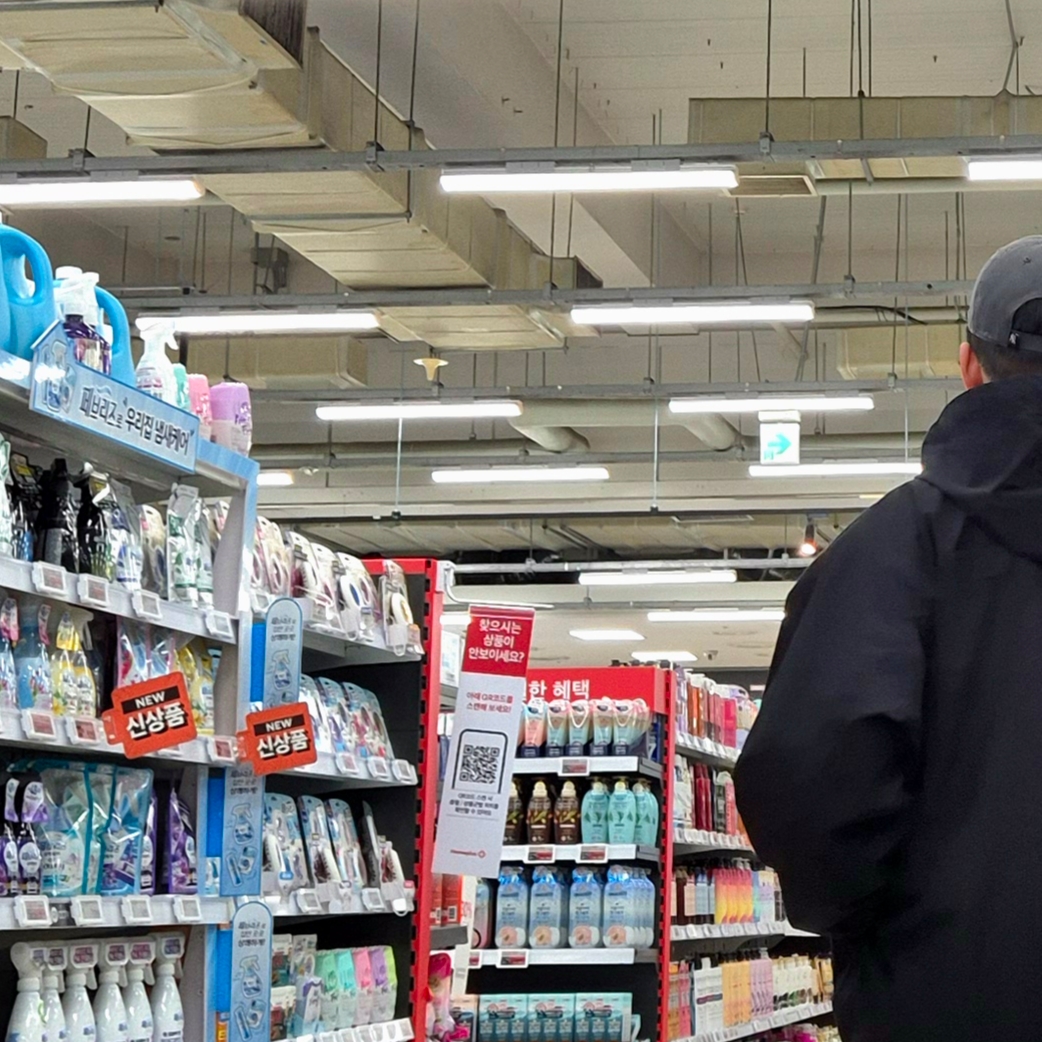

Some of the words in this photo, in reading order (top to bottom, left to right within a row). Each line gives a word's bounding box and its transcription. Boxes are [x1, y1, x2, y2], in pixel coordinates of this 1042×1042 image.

[125, 407, 155, 440] 우리집
[155, 420, 190, 456] 냄새케어
[479, 619, 522, 634] 찾으시는
[483, 634, 515, 649] 상품이
[468, 647, 525, 662] 안보이세요?
[134, 690, 166, 709] NEW
[526, 680, 548, 701] 한
[552, 679, 591, 701] 혜택
[126, 702, 187, 740] 신상품
[265, 718, 293, 733] NEW
[257, 728, 309, 760] 신상품
